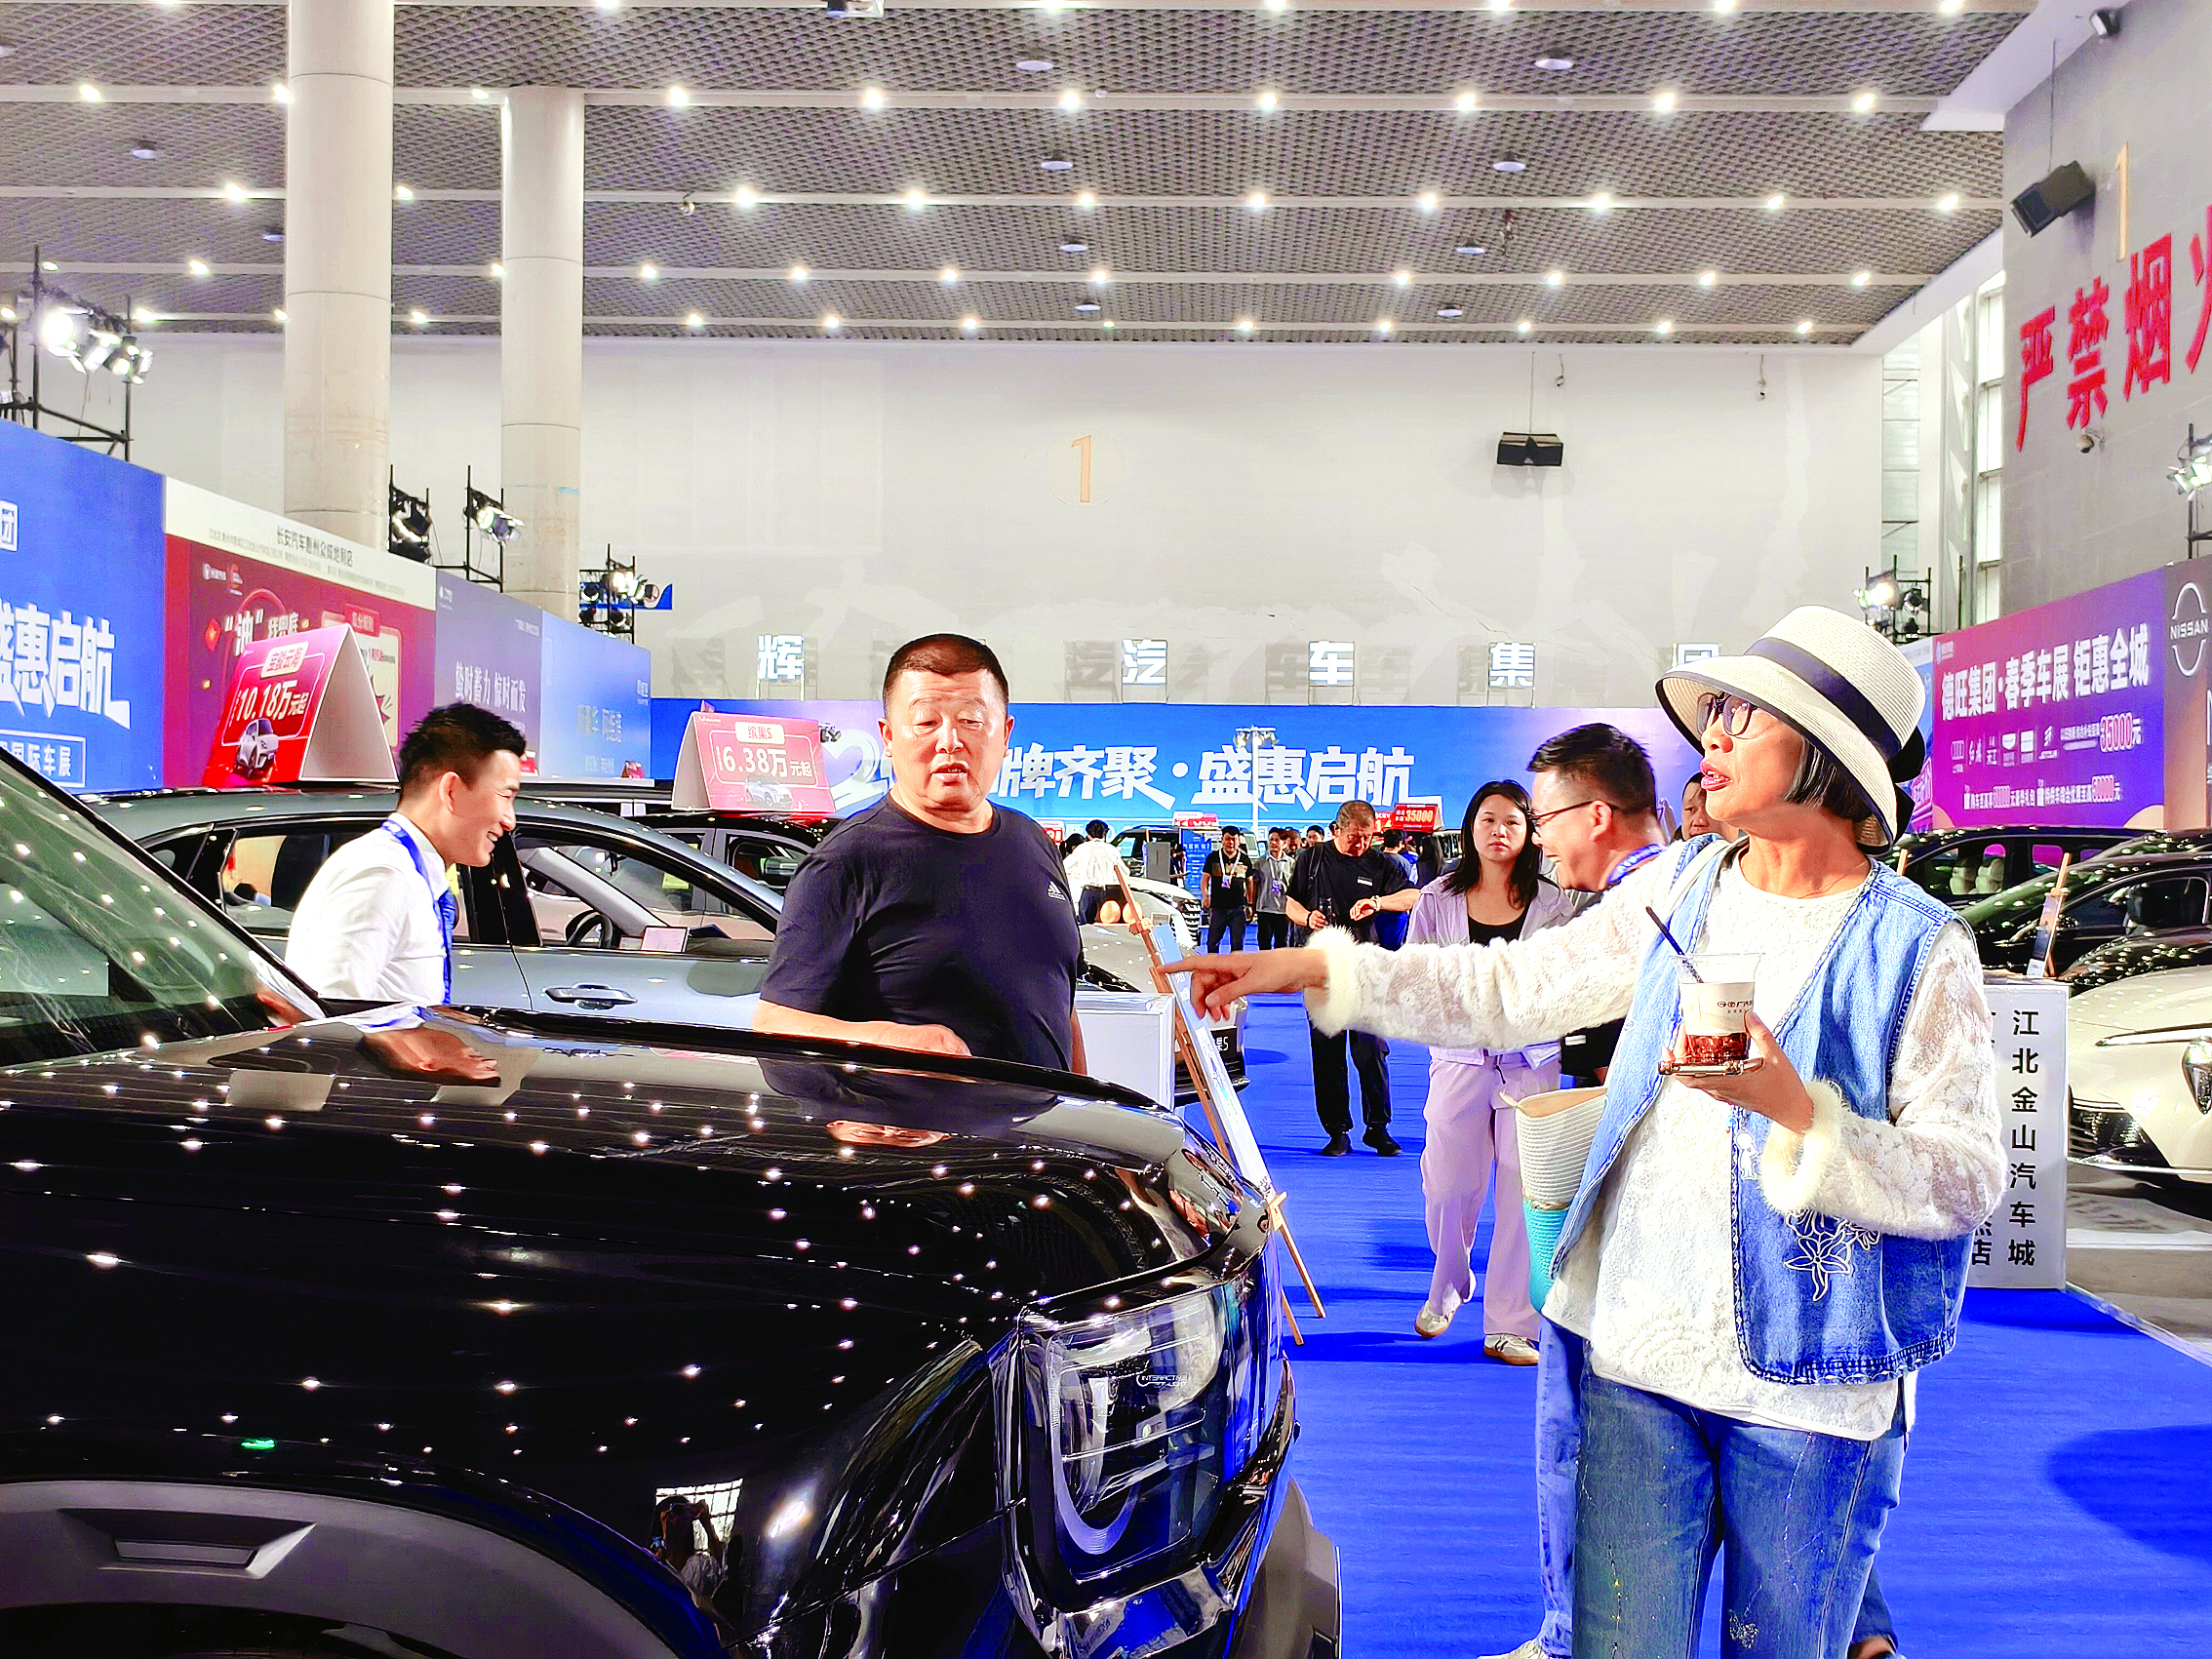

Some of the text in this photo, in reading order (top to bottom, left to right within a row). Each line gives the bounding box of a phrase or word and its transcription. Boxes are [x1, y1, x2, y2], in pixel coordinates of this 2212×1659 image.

[2115, 142, 2129, 262] 1
[1071, 435, 1091, 503] 1
[2170, 618, 2209, 640] NISSAN
[988, 741, 1442, 812] 牌齐聚·盛惠启航
[2007, 1009, 2040, 1267] 江北金山汽车城
